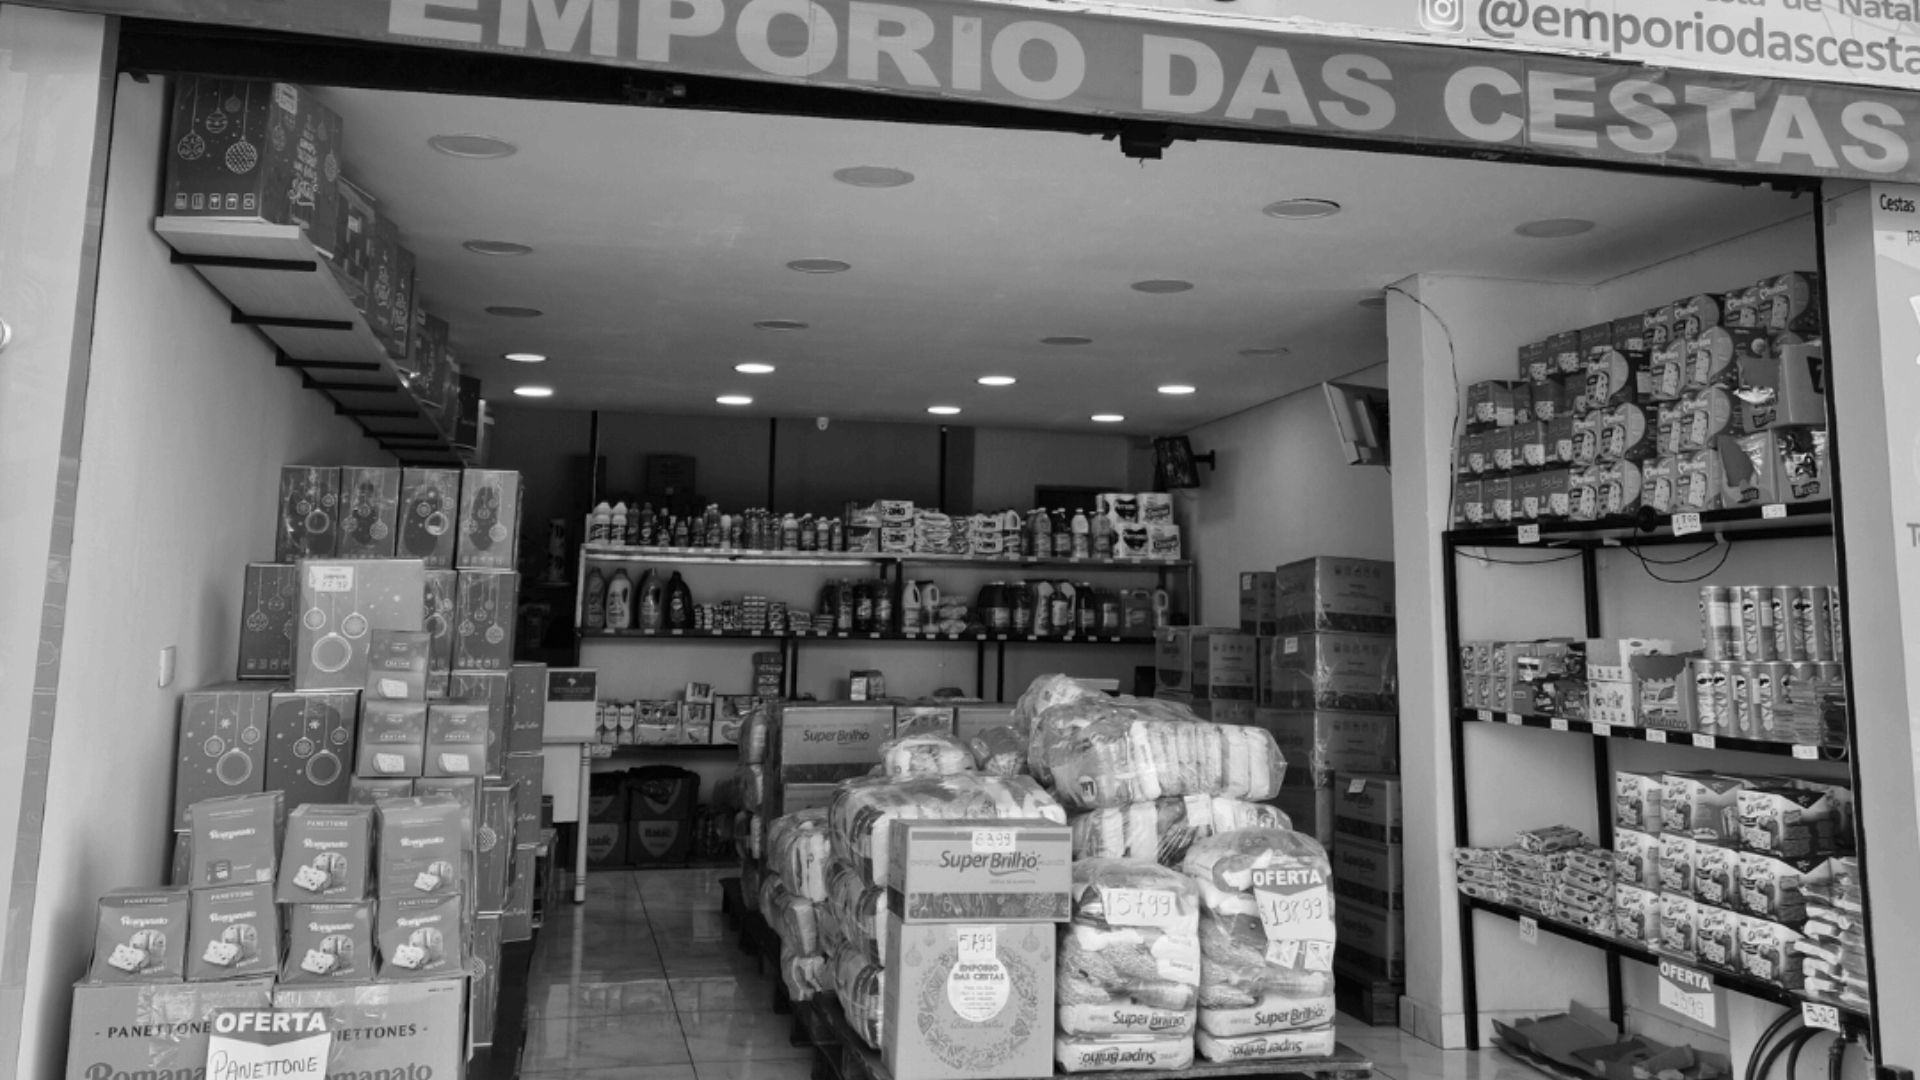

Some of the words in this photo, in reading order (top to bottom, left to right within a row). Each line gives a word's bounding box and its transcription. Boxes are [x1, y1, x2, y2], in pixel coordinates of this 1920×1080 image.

[1839, 0, 1919, 23] Natal
[388, 0, 1086, 101] EMPORIO
[1141, 34, 1396, 132] DAS
[1443, 66, 1909, 172] CESTAS
[1880, 193, 1915, 213] Cestas
[1906, 522, 1920, 548] T
[1253, 869, 1323, 887] OFERTA
[1660, 961, 1711, 992] OFERTA
[215, 1011, 327, 1033] OFERTA
[211, 1050, 319, 1080] PANETTONE
